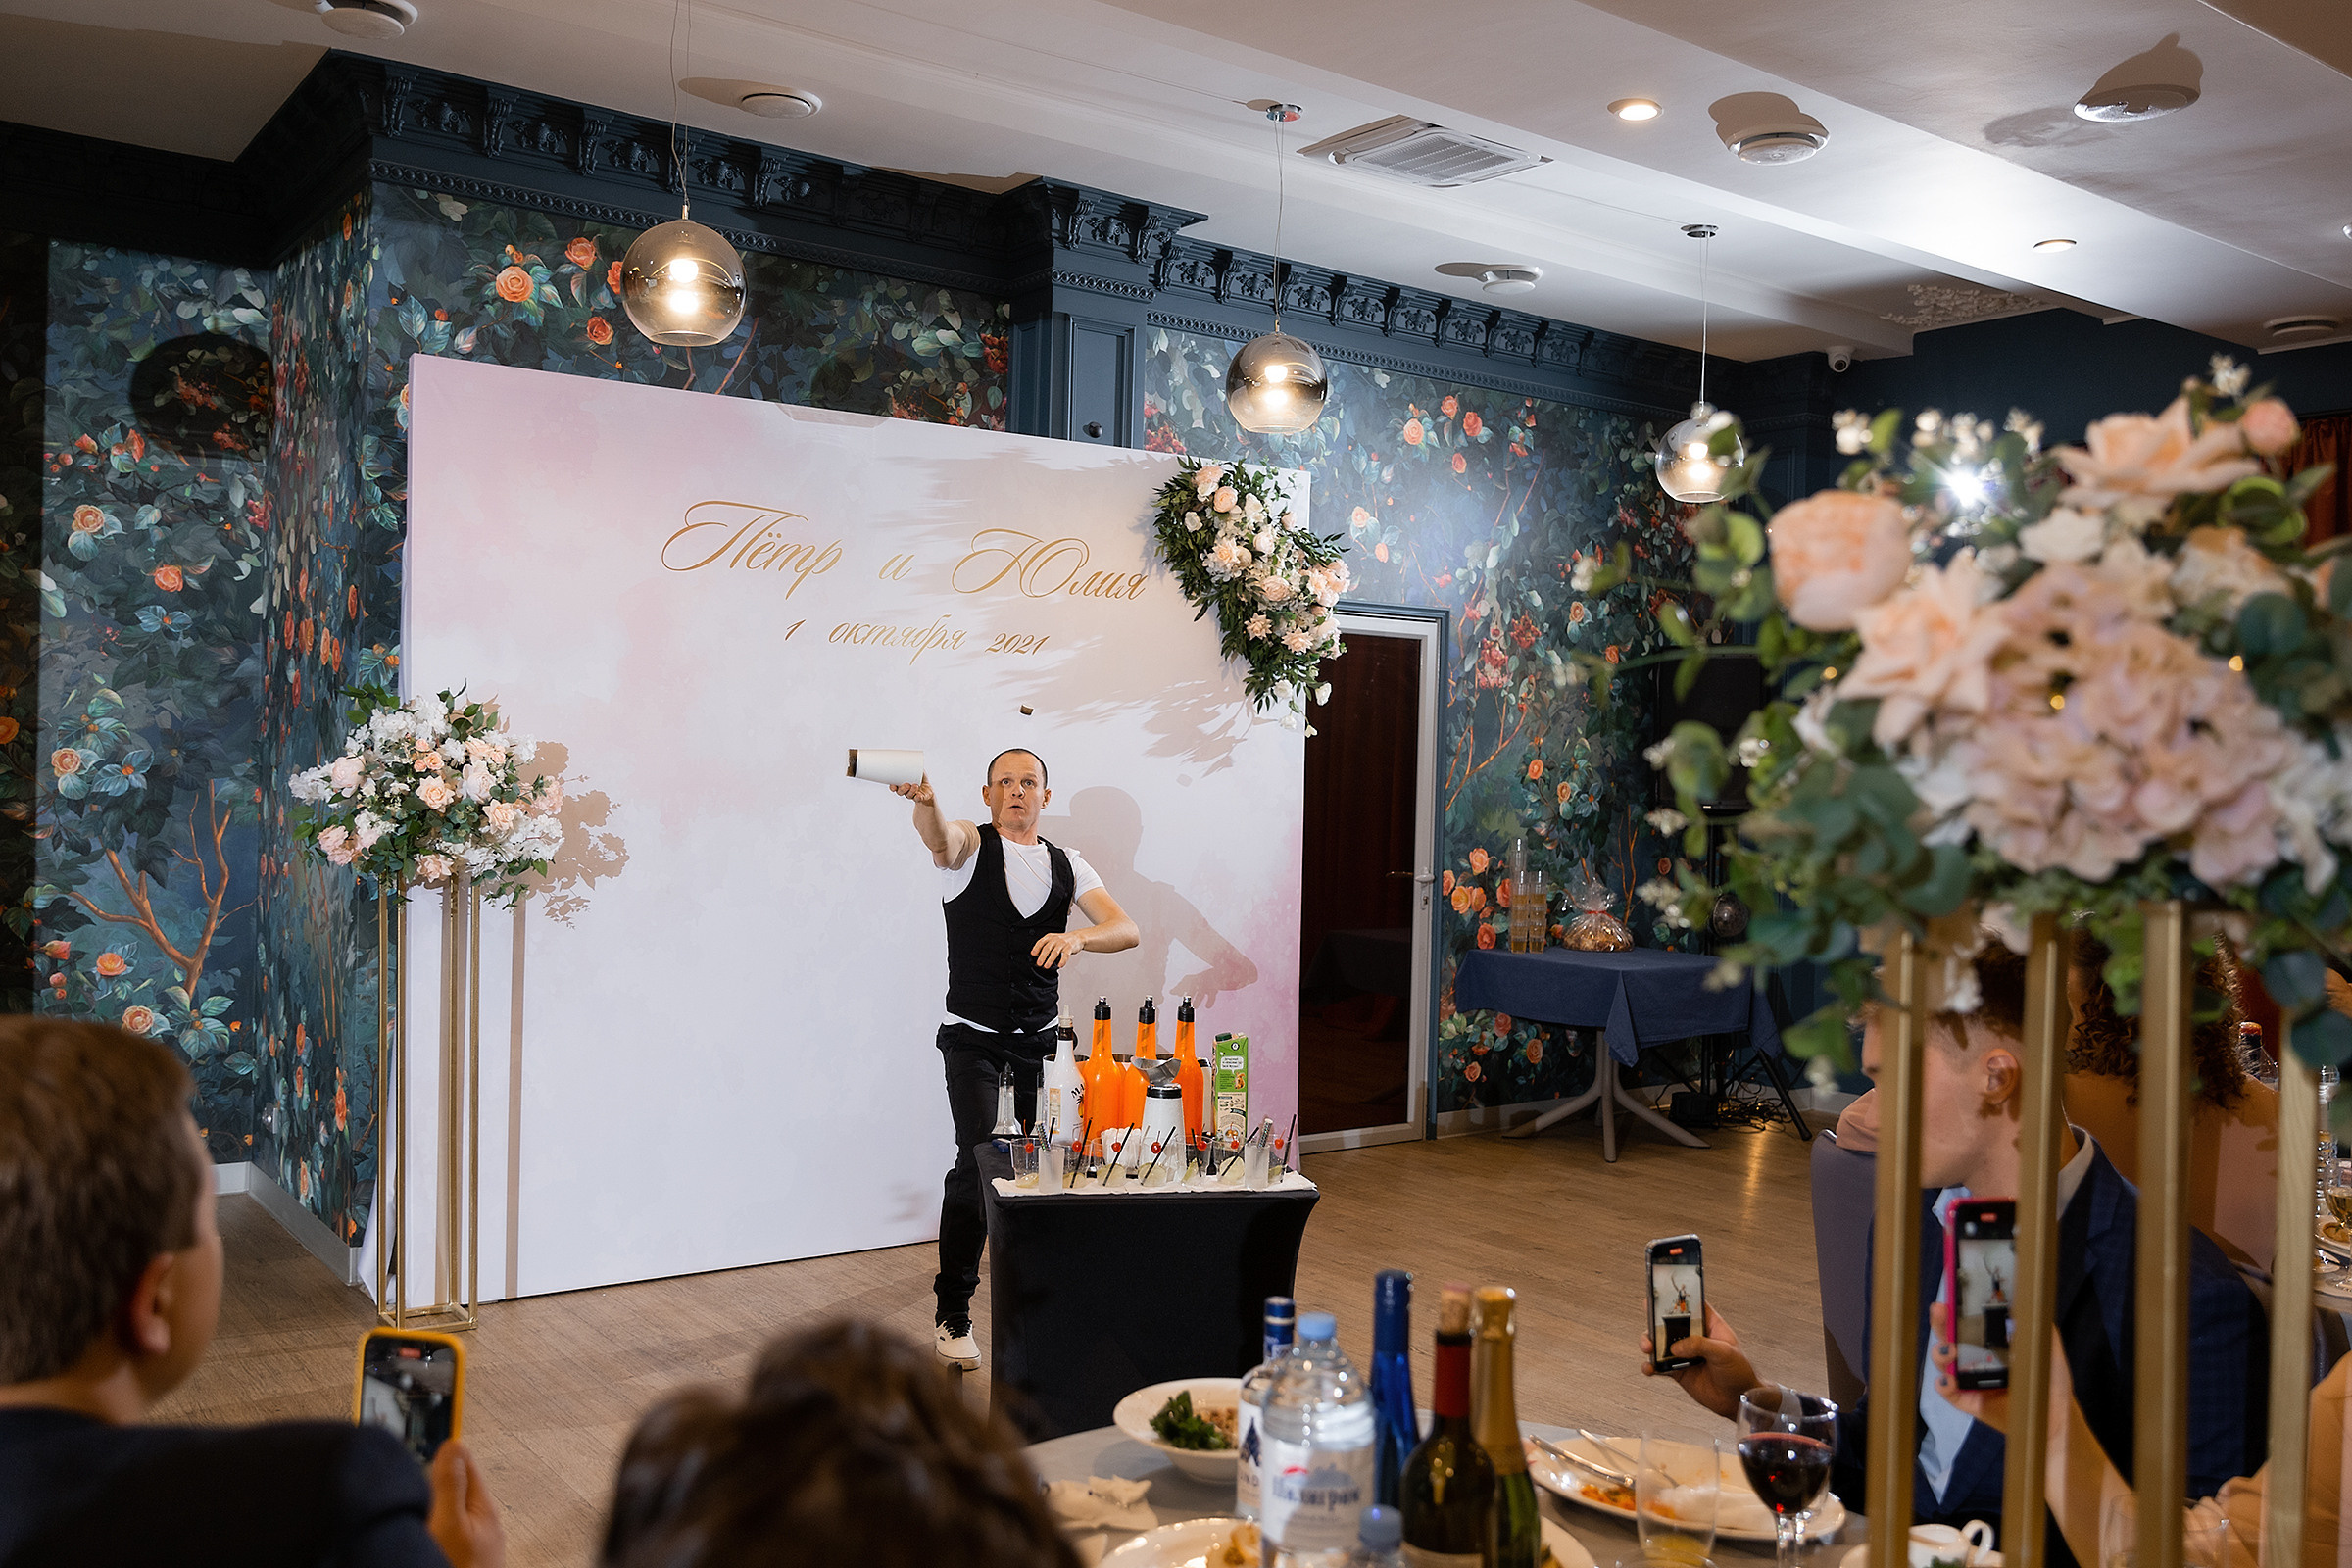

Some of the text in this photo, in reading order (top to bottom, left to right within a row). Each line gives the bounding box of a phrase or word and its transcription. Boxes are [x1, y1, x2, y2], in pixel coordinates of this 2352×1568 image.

[662, 500, 1147, 600] Пётр и Юлия
[785, 613, 1050, 666] 1 октября 2021
